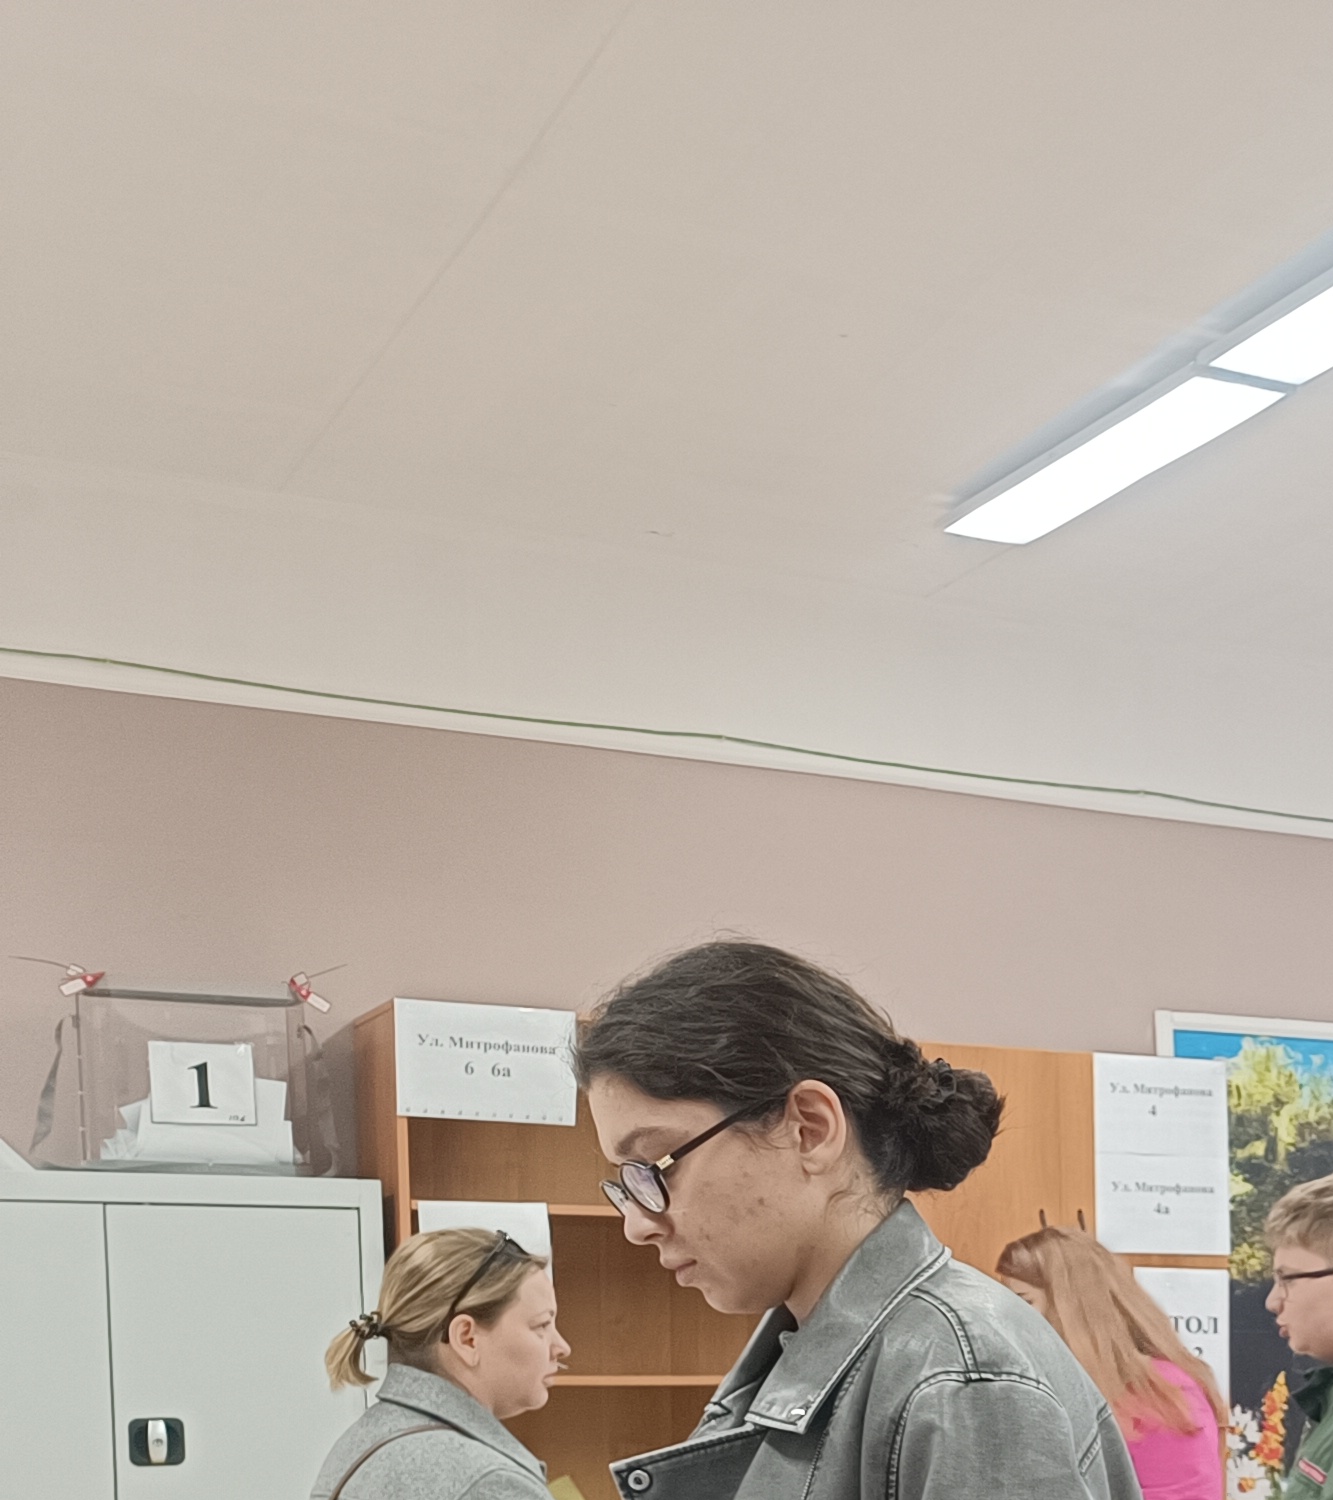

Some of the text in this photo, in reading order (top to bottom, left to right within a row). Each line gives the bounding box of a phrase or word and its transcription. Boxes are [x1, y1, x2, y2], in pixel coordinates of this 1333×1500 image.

[417, 1033, 556, 1055] Ул. Митрофанова
[464, 1061, 511, 1078] 6 6а
[187, 1061, 218, 1109] 1
[1169, 1315, 1218, 1334] ТОЛ
